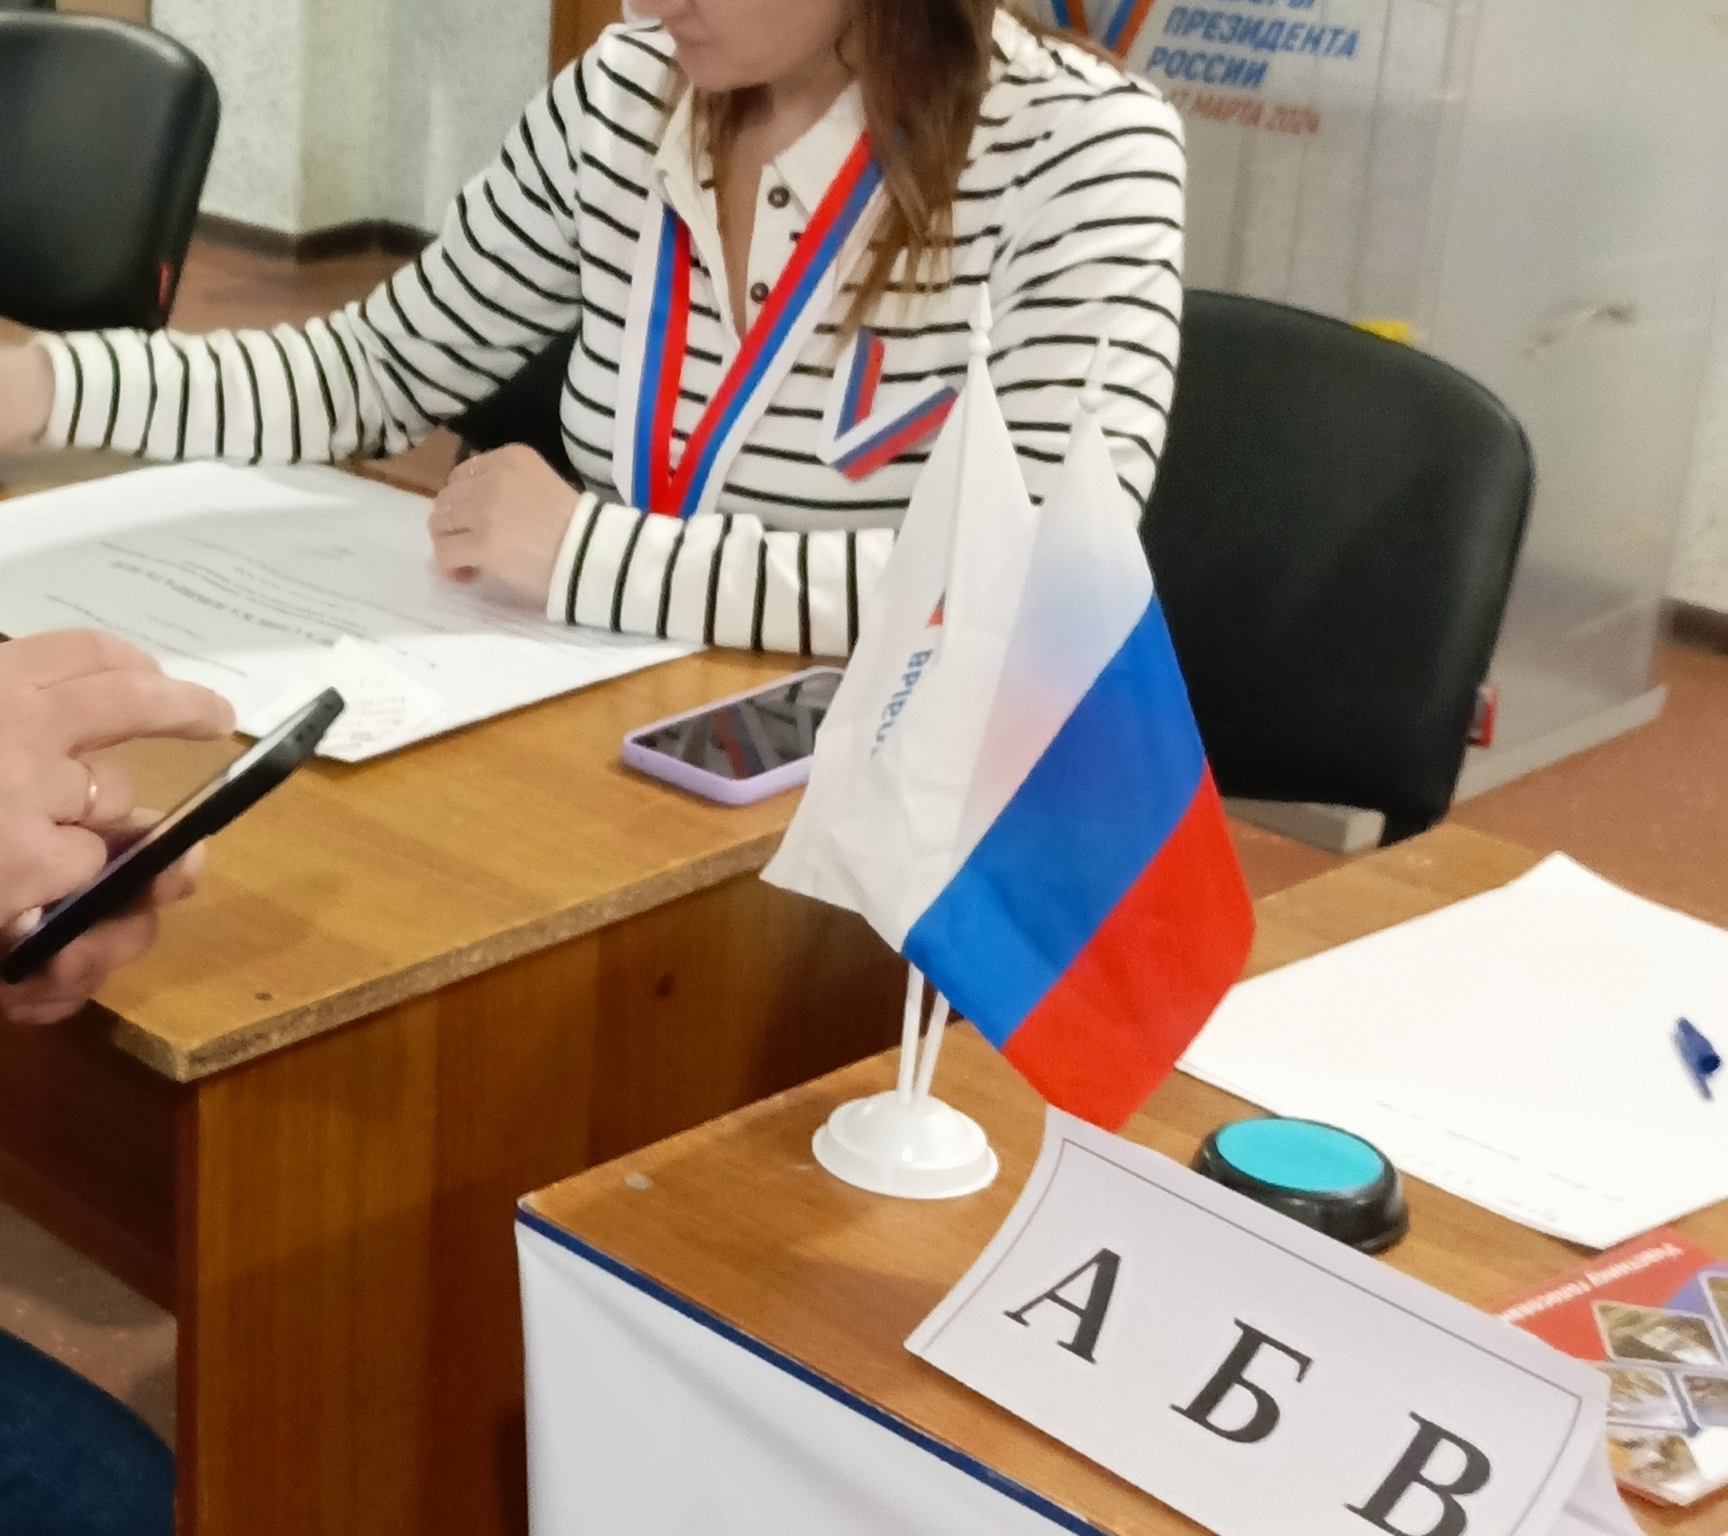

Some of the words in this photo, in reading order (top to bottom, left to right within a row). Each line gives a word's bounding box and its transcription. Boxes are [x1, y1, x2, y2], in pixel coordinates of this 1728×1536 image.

[1163, 5, 1361, 60] ПРЕЗИДЕНТА
[1146, 45, 1270, 89] РОССИИ
[1003, 1246, 1123, 1366] А
[1168, 1317, 1314, 1445] Б
